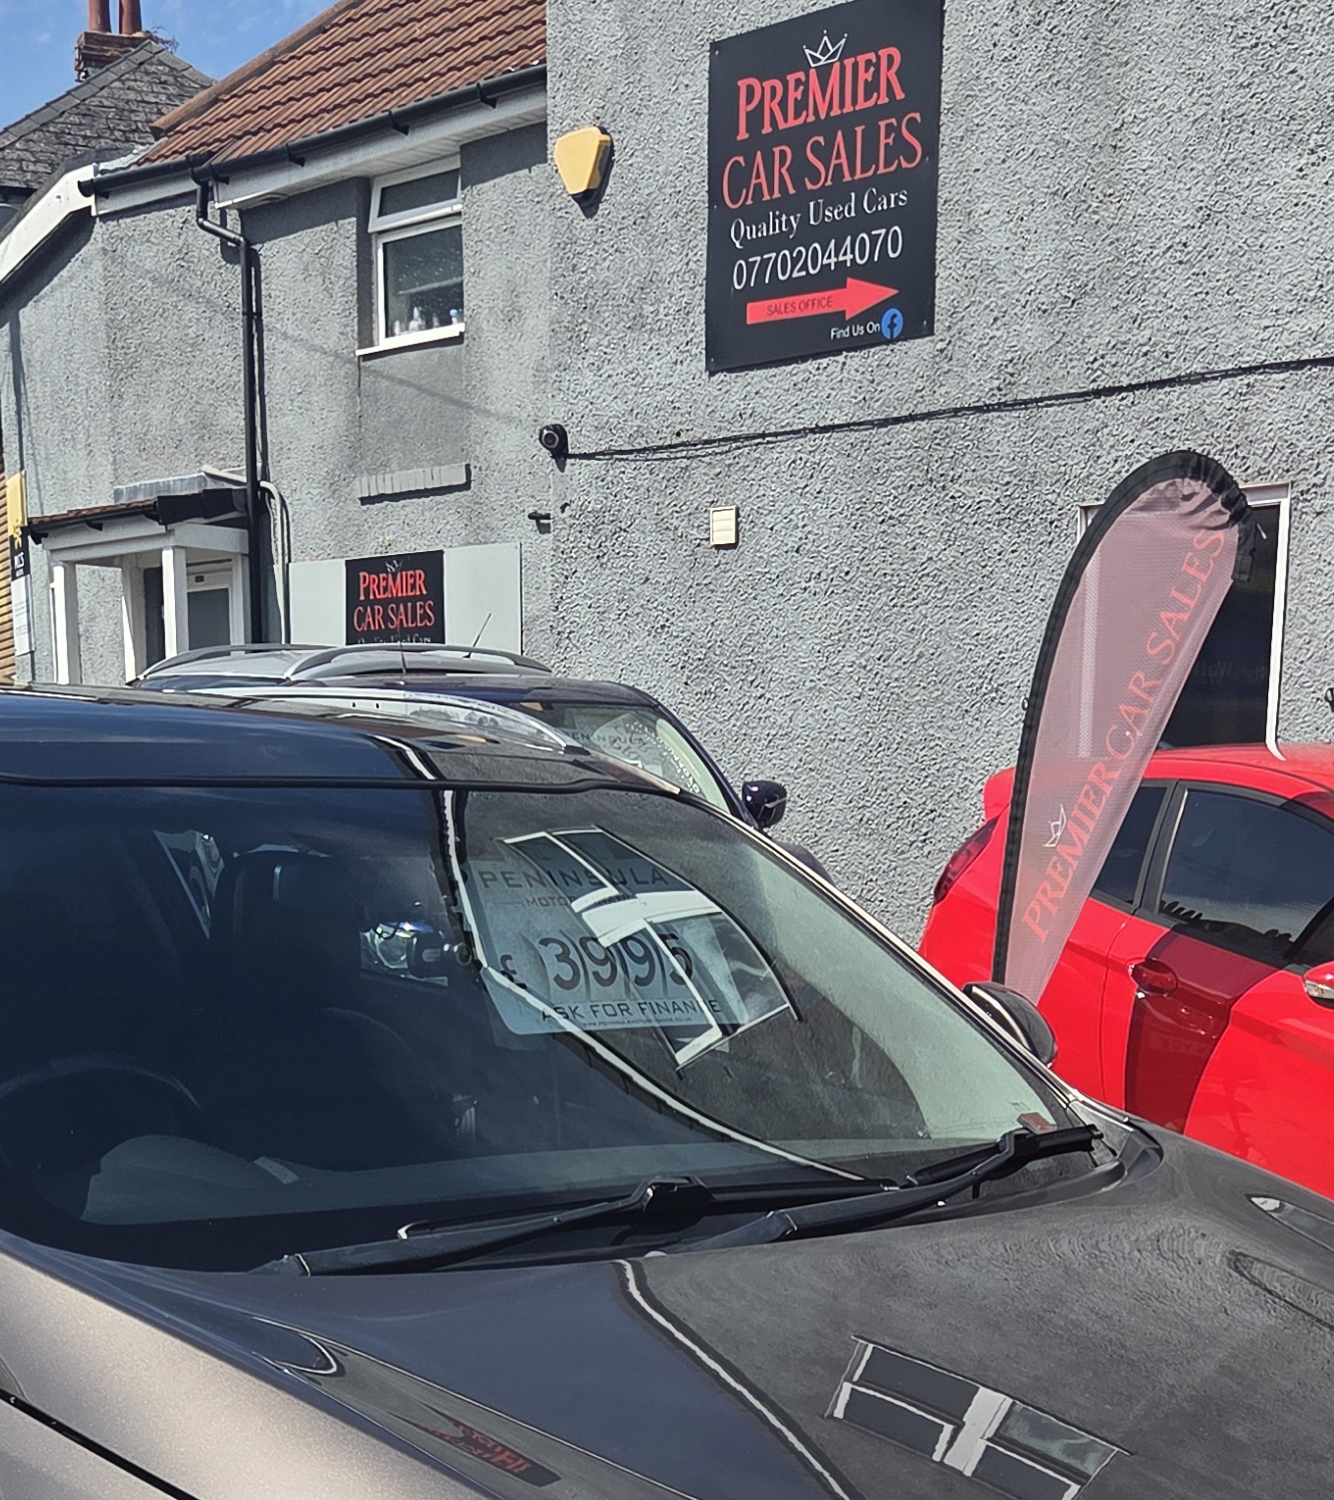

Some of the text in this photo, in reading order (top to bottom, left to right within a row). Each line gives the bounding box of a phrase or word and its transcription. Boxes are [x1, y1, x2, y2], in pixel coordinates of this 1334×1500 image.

[736, 47, 906, 141] PREMIER
[722, 112, 923, 210] CAR SALES
[730, 187, 909, 249] Quality Used Cars
[732, 225, 904, 290] 07702044070
[766, 296, 834, 317] SALES OFFICE
[830, 325, 850, 341] Find
[851, 324, 865, 337] Us
[866, 321, 881, 334] On
[358, 569, 427, 601] PREMIER
[353, 600, 436, 632] CAR SALES
[1021, 528, 1226, 943] PREMIER CAR SALES
[477, 867, 669, 889] PENINSULA
[589, 1003, 634, 1018] FOR
